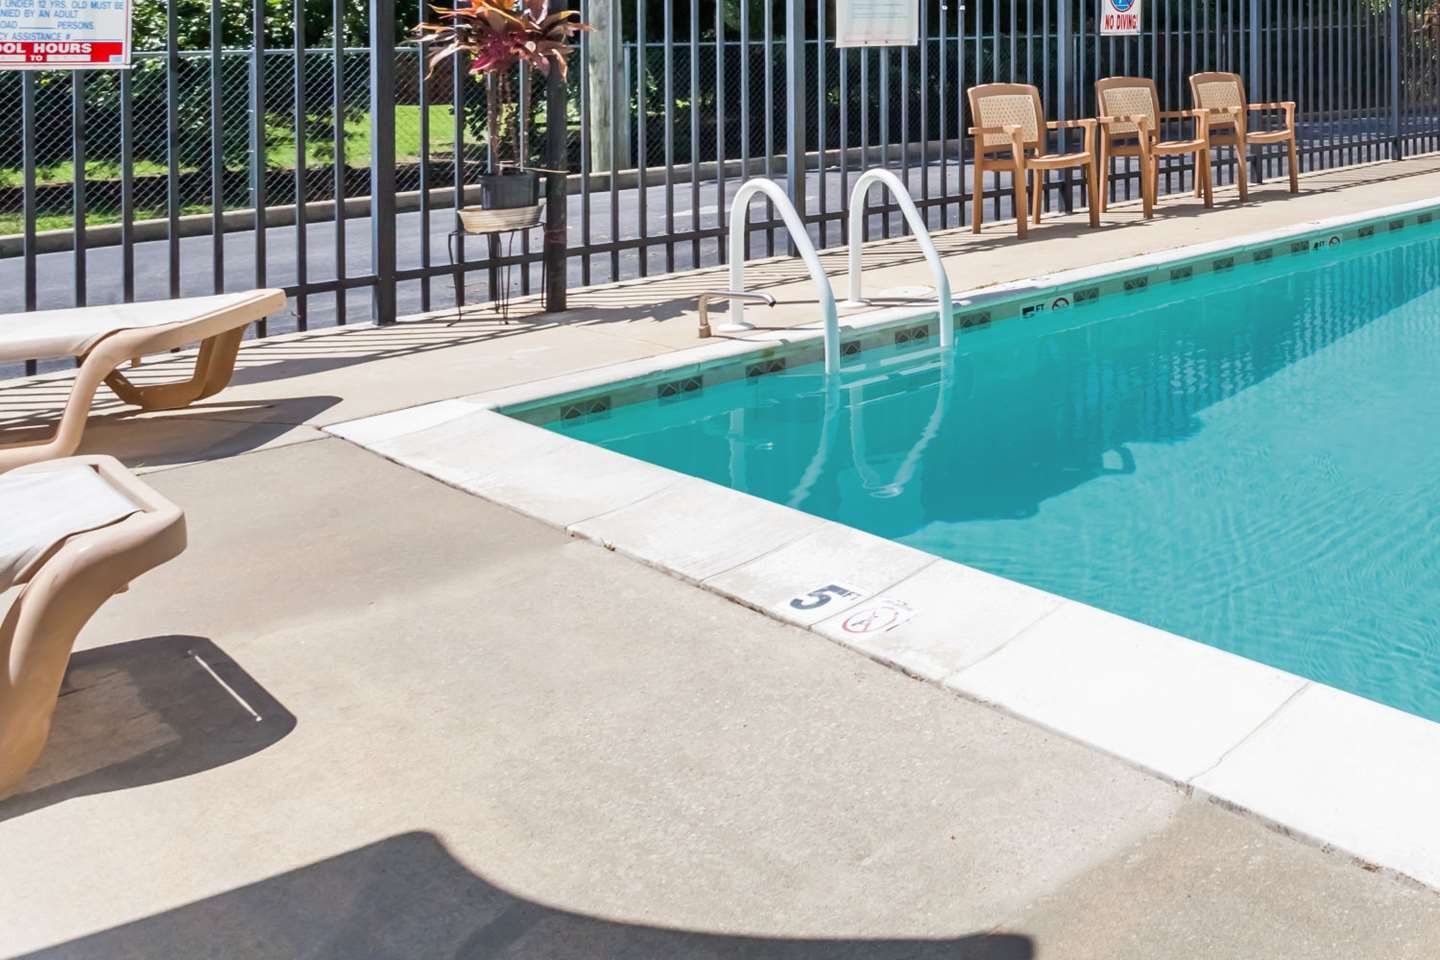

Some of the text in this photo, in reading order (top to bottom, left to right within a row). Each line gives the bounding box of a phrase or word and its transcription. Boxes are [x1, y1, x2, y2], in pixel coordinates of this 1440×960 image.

[5, 0, 34, 8] UNDER
[90, 1, 112, 10] MUST
[53, 10, 79, 18] ADULT
[1104, 15, 1115, 30] NO
[12, 32, 62, 41] ASSISTANCE
[33, 42, 93, 54] HOURS
[789, 584, 849, 610] 5
